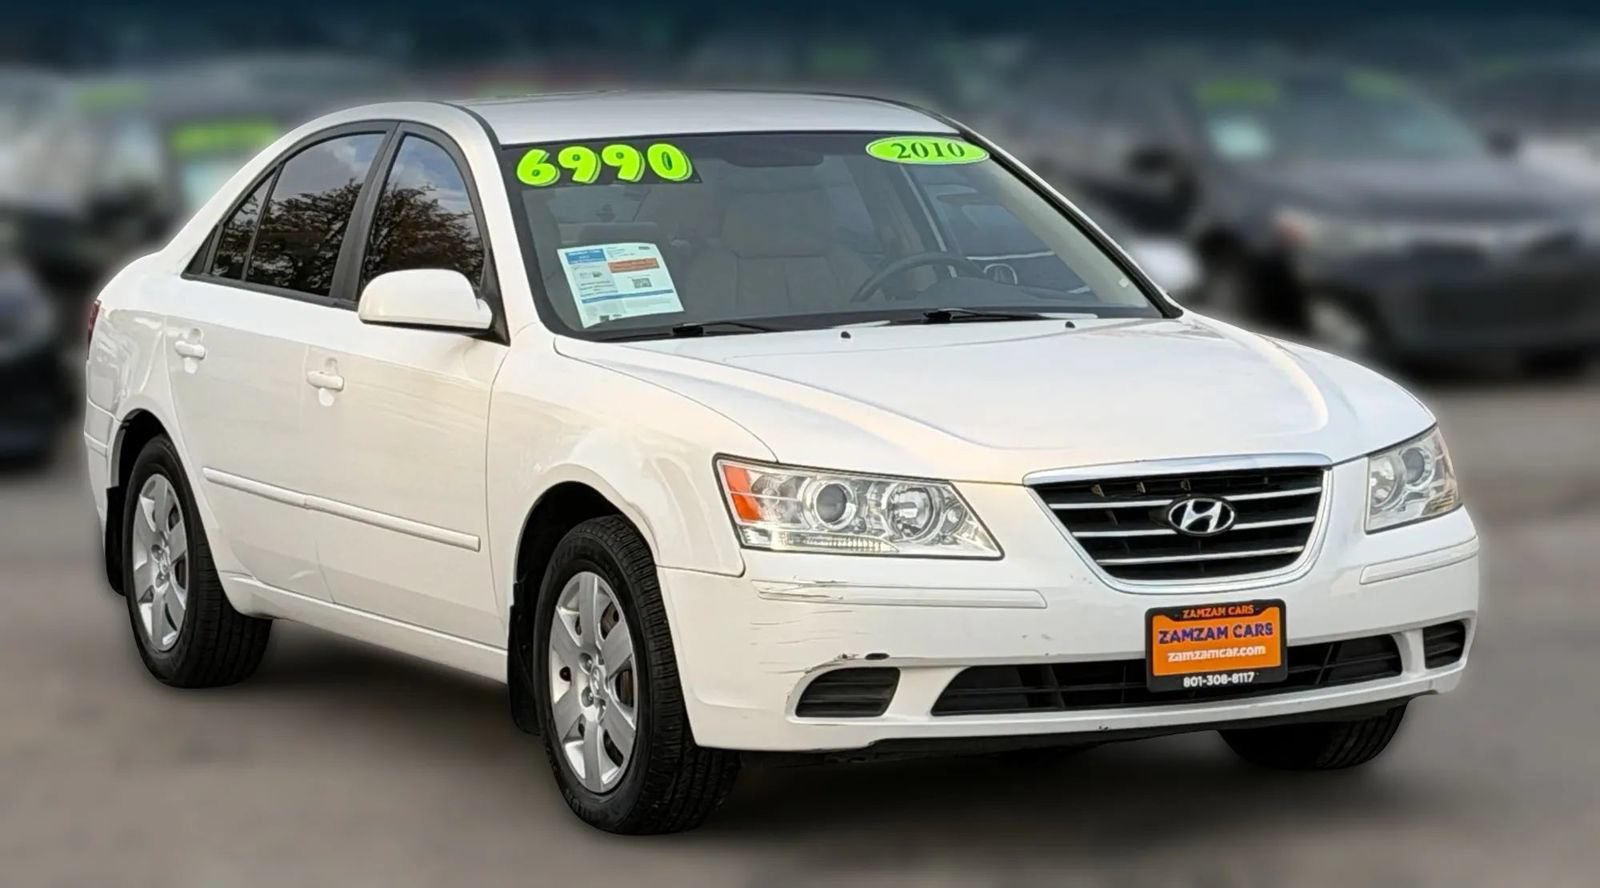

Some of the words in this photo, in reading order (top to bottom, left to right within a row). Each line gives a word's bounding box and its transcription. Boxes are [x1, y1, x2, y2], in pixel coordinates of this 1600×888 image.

[890, 142, 966, 159] 2010
[516, 143, 693, 187] 6990
[1182, 607, 1227, 619] ZAMZAM
[1228, 604, 1255, 616] CARS
[1158, 626, 1228, 644] ZAMZAM
[1233, 622, 1273, 638] CARS
[1167, 645, 1266, 663] zamzamcar.com
[1183, 671, 1255, 688] 801-308-8117
